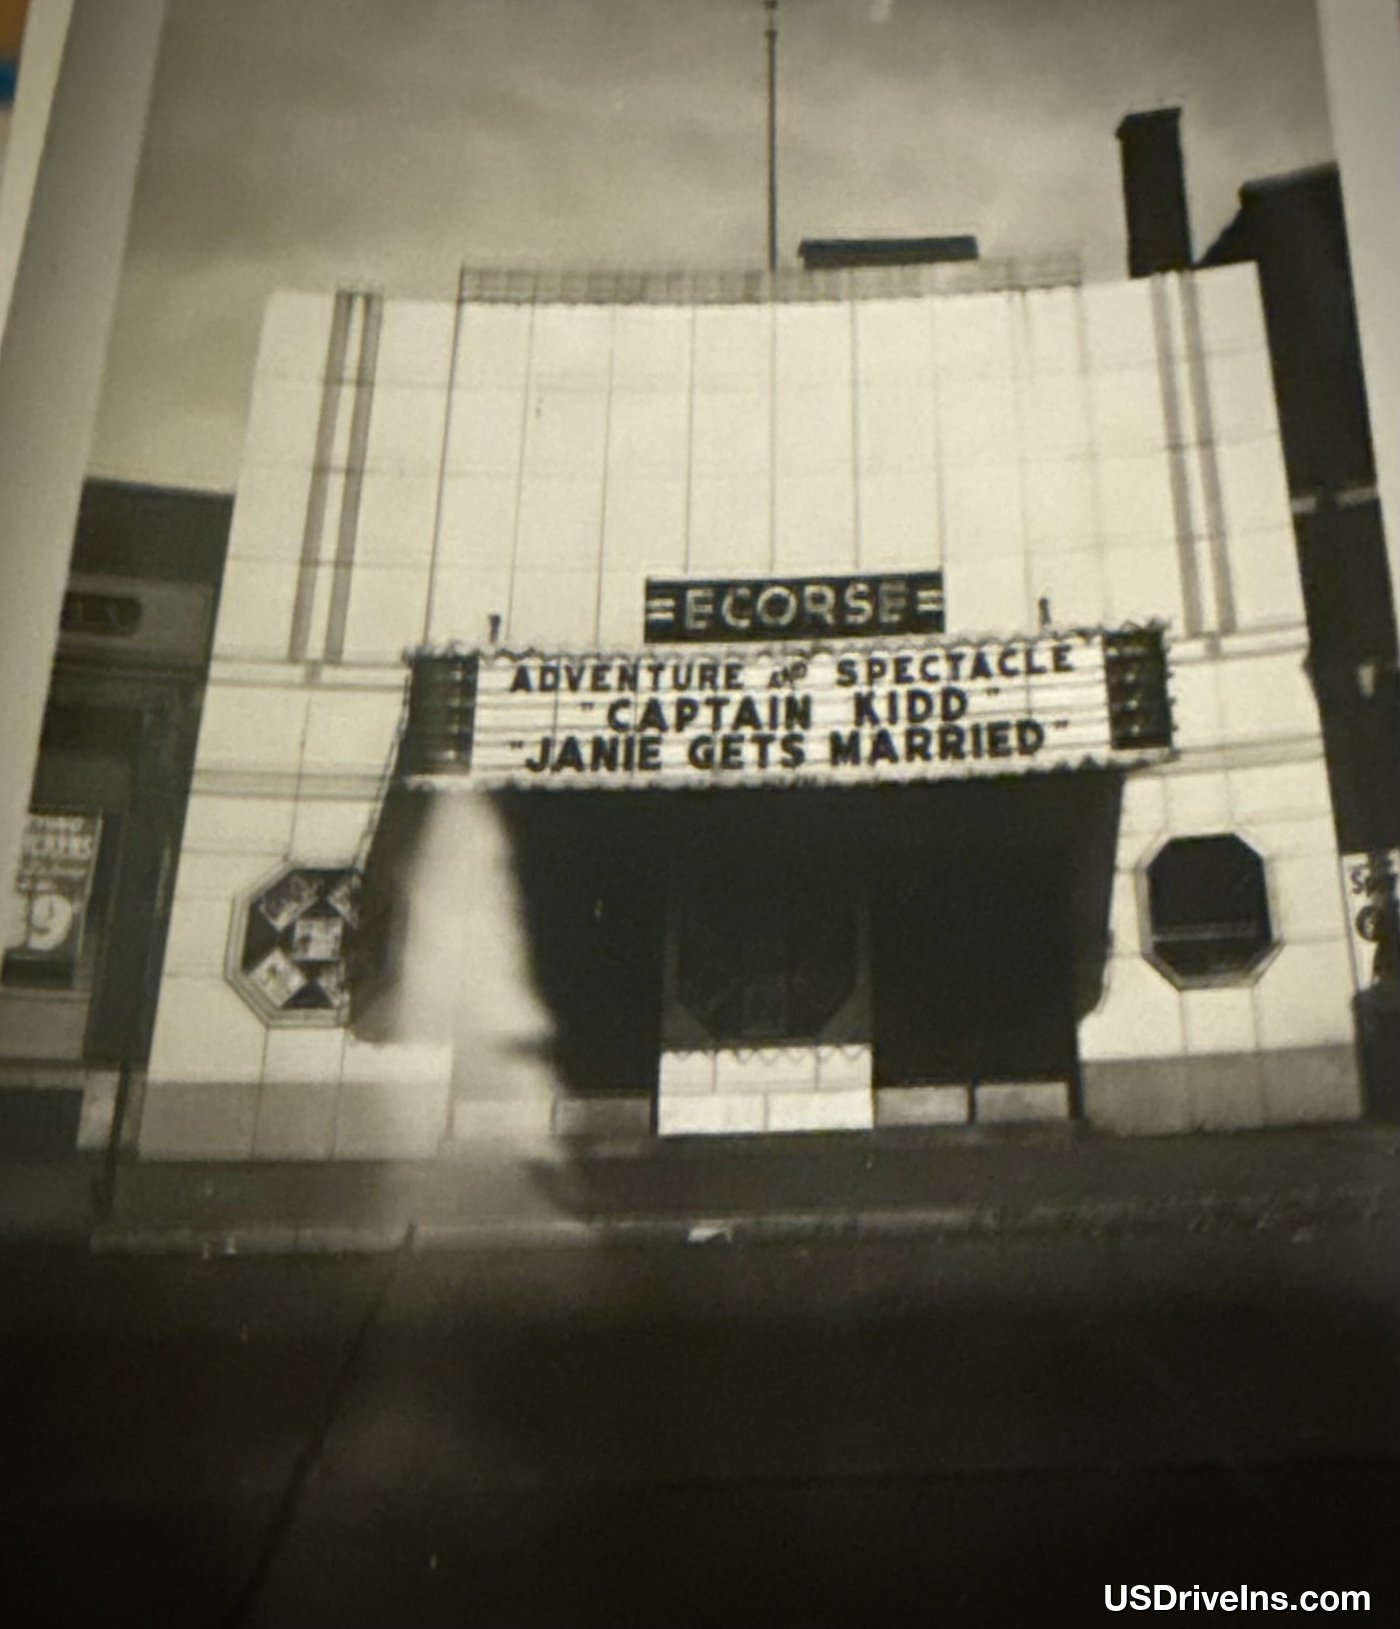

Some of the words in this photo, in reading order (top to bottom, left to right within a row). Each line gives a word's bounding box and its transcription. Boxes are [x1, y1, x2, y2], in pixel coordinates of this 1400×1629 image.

[684, 581, 910, 631] ECORSE
[510, 662, 744, 693] ADVENTURE
[836, 644, 1074, 686] SPECTACLE
[688, 732, 806, 770] GETS
